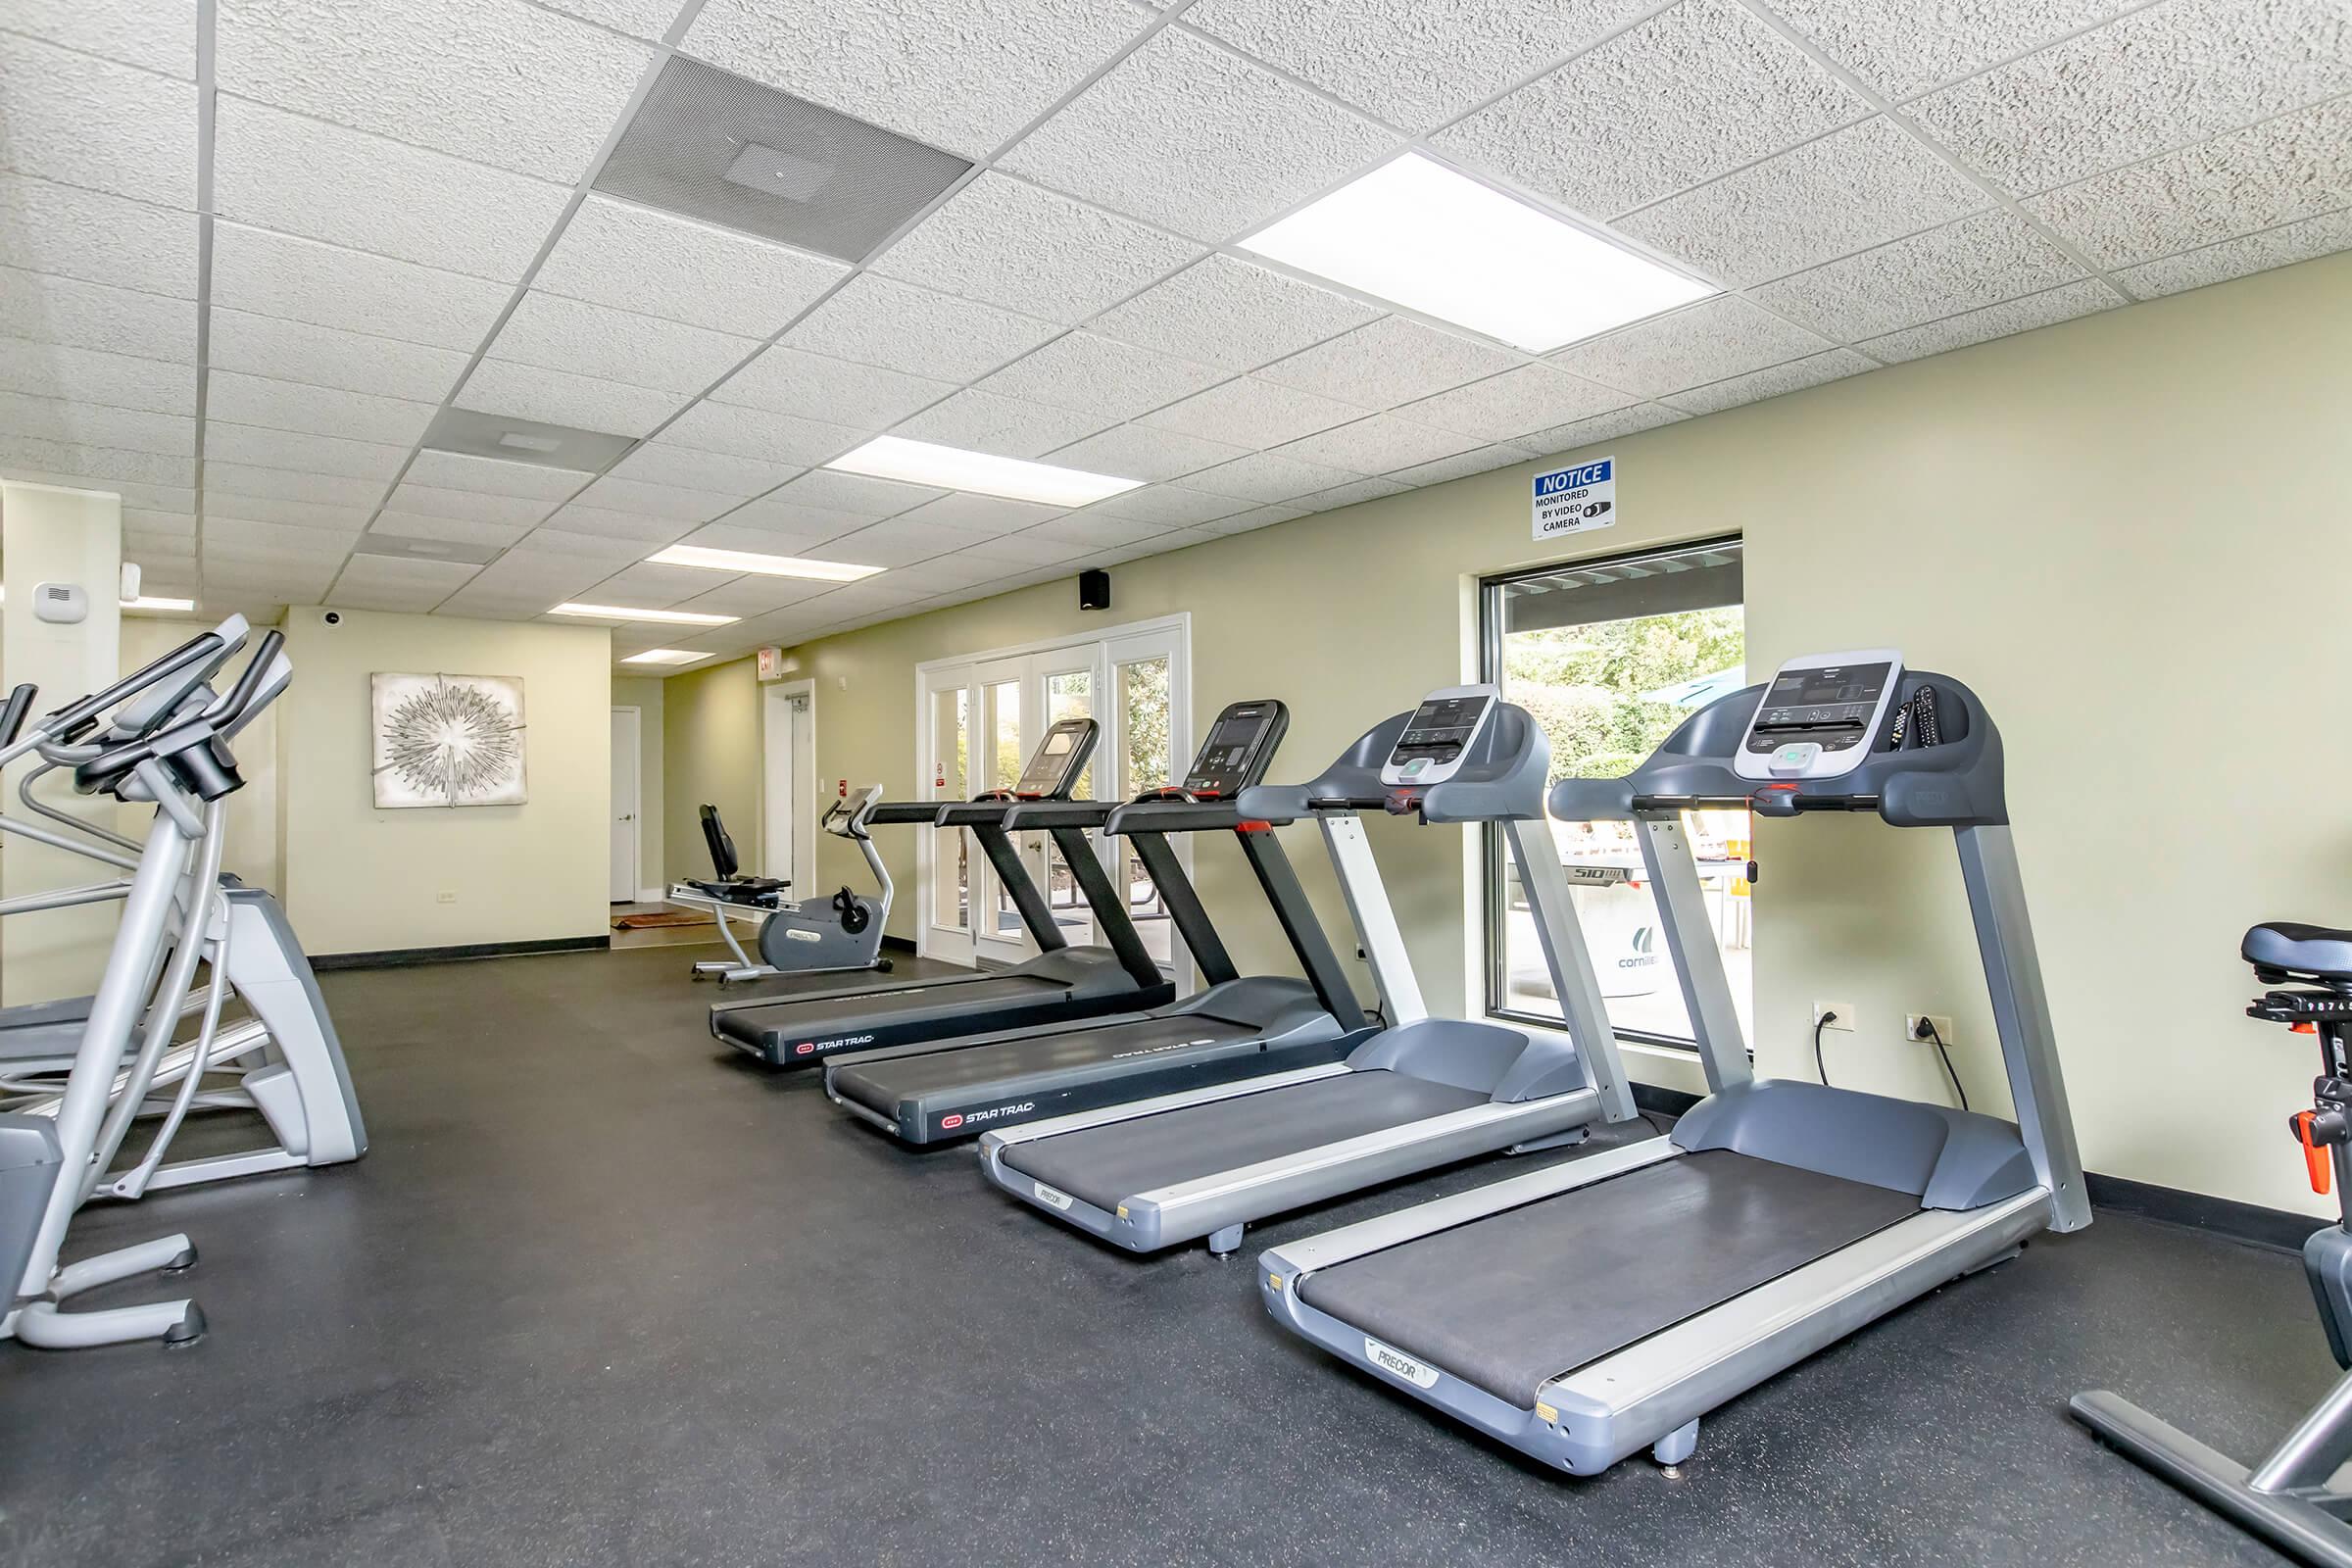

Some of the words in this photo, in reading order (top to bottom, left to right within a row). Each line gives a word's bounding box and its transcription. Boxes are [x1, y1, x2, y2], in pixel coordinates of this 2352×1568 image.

[1543, 465, 1603, 493] NOTICE
[1536, 488, 1589, 508] MONITORED
[1542, 510, 1553, 519] BY
[1554, 504, 1582, 516] VIDEO
[1544, 516, 1581, 531] CAMERA
[1574, 868, 1606, 878] 510
[2308, 1003, 2315, 1011] 9
[2318, 1002, 2325, 1011] 8
[2328, 1002, 2334, 1010] 7
[2338, 1002, 2345, 1010] 6
[816, 1040, 843, 1051] STAR
[845, 1035, 872, 1046] TRAC
[965, 1108, 998, 1123] STAR
[1000, 1102, 1034, 1116] TRAC
[1378, 1350, 1416, 1379] PRECOR
